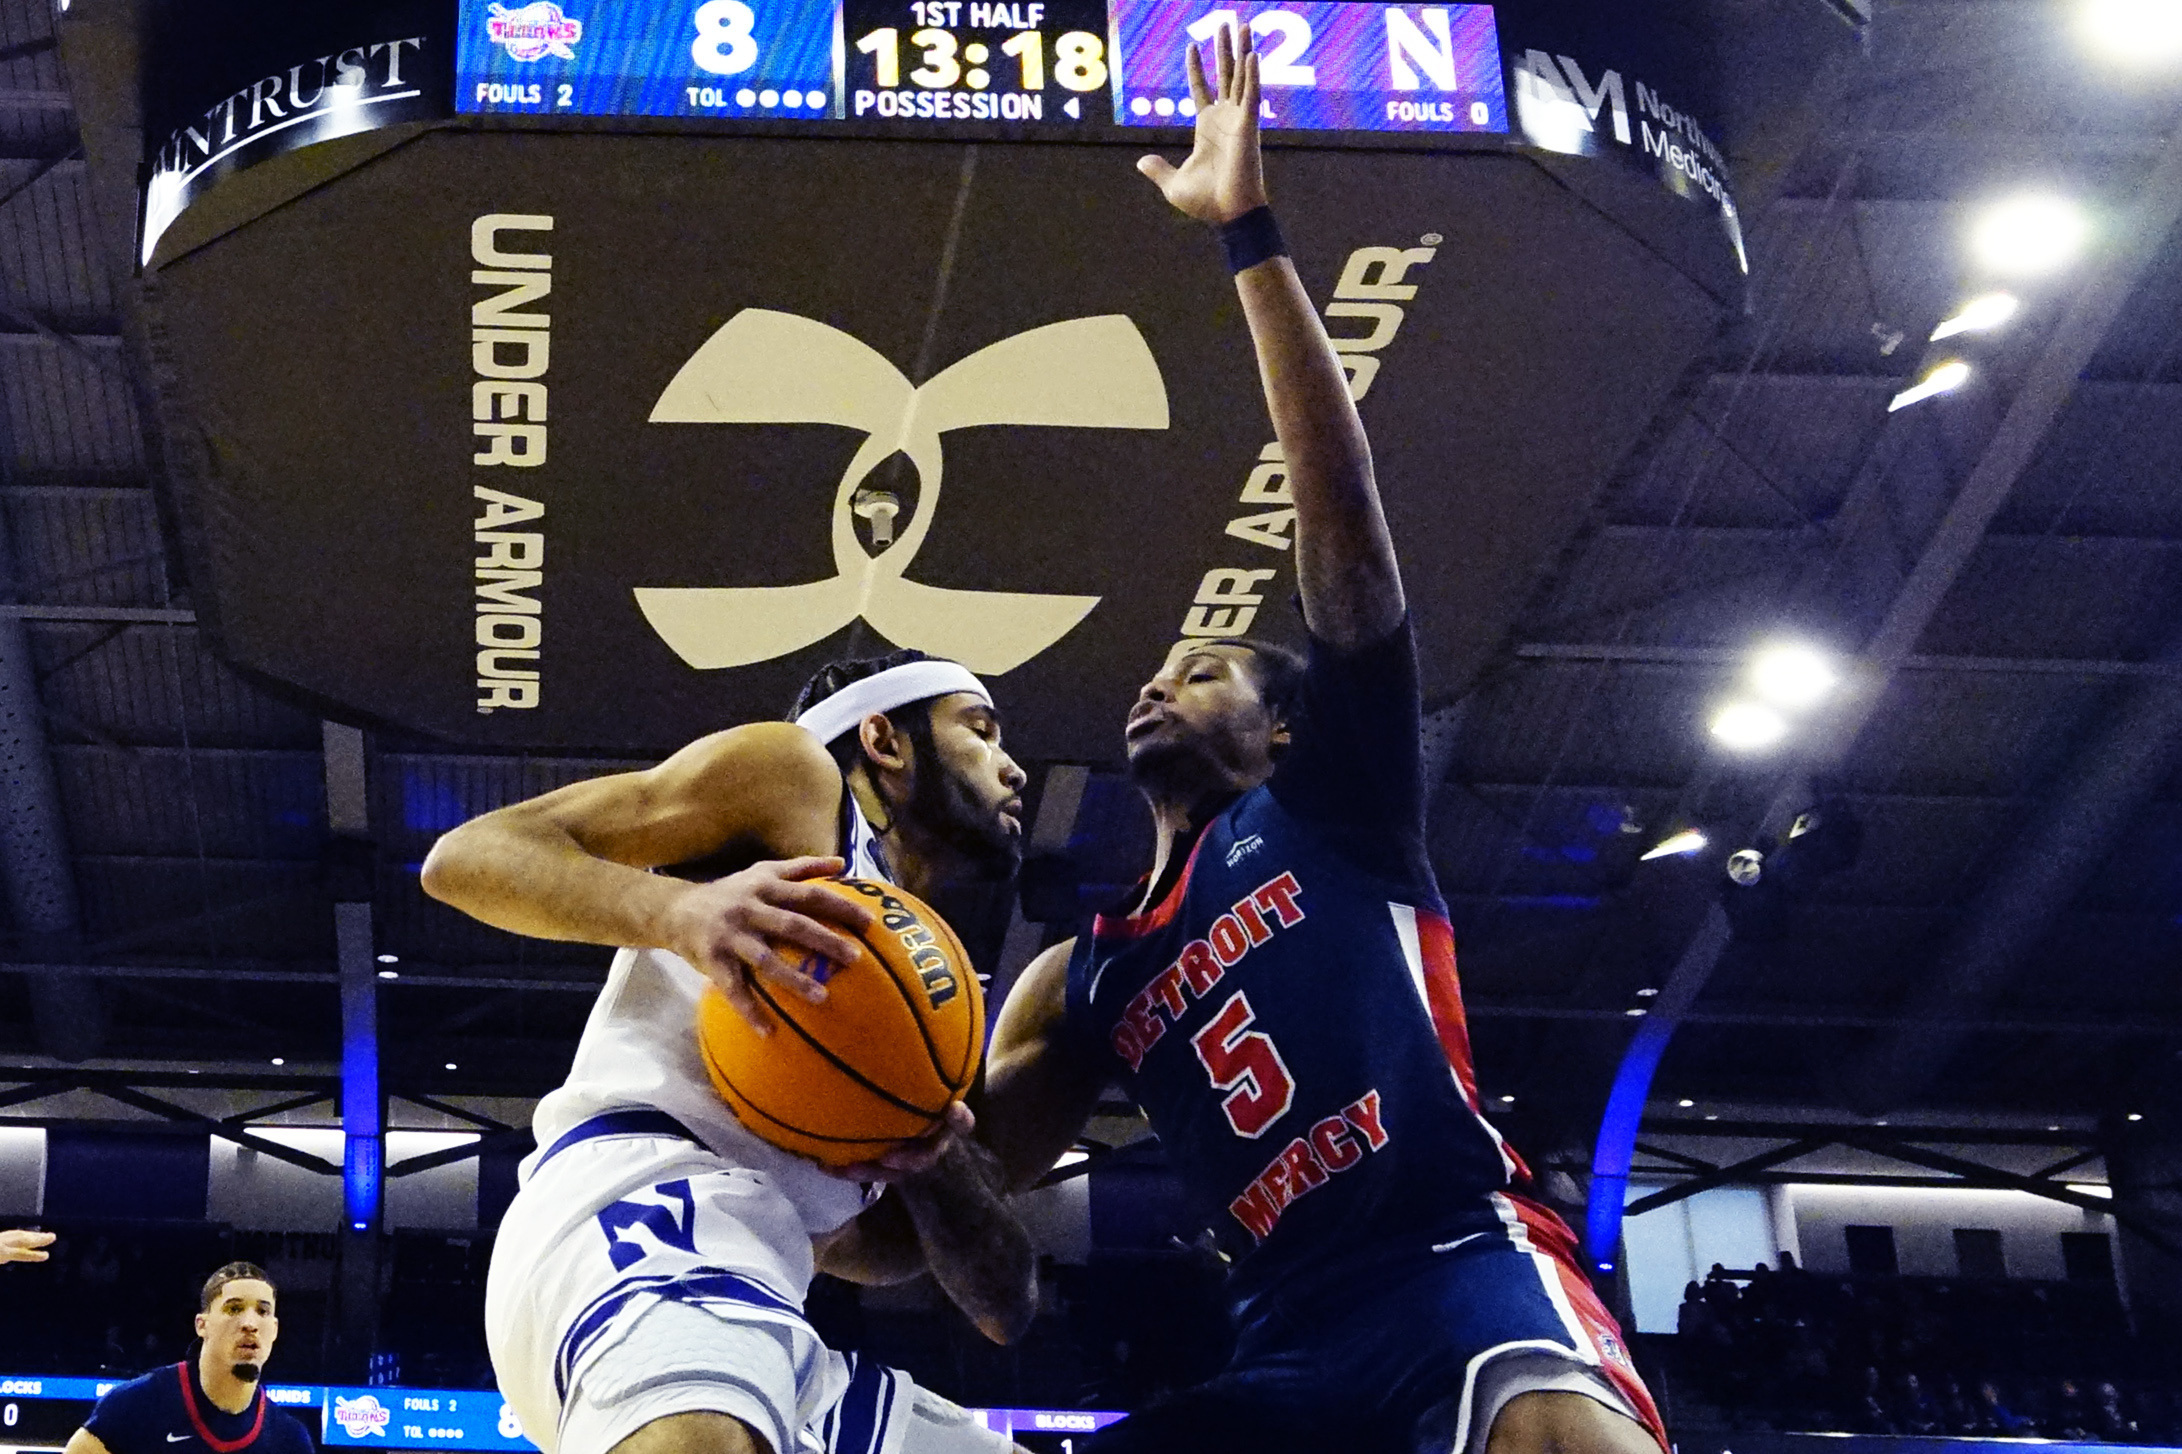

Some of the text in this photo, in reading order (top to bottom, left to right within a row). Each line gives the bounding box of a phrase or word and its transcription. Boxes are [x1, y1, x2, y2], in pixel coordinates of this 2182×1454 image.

[910, 2, 1044, 28] 1ST HALF
[691, 0, 759, 75] 8
[1186, 9, 1317, 86] 12
[1385, 8, 1457, 91] N
[856, 28, 1108, 91] 13:18
[476, 83, 573, 107] FOULS 2
[686, 86, 727, 108] TOL
[855, 90, 1042, 119] POSSESSION
[1387, 101, 1490, 125] FOULS 0
[471, 213, 553, 708] UNDER ARMOUR
[1111, 870, 1305, 1073] DETROIT
[1190, 989, 1296, 1140] 5
[1228, 1088, 1389, 1242] MERCY
[597, 1179, 705, 1273] N
[0, 1380, 42, 1395] OCKS
[4, 1403, 19, 1426] 0
[404, 1397, 458, 1412] FOULS 2
[403, 1425, 424, 1438] TOL
[1035, 1414, 1096, 1429] BLOCKS
